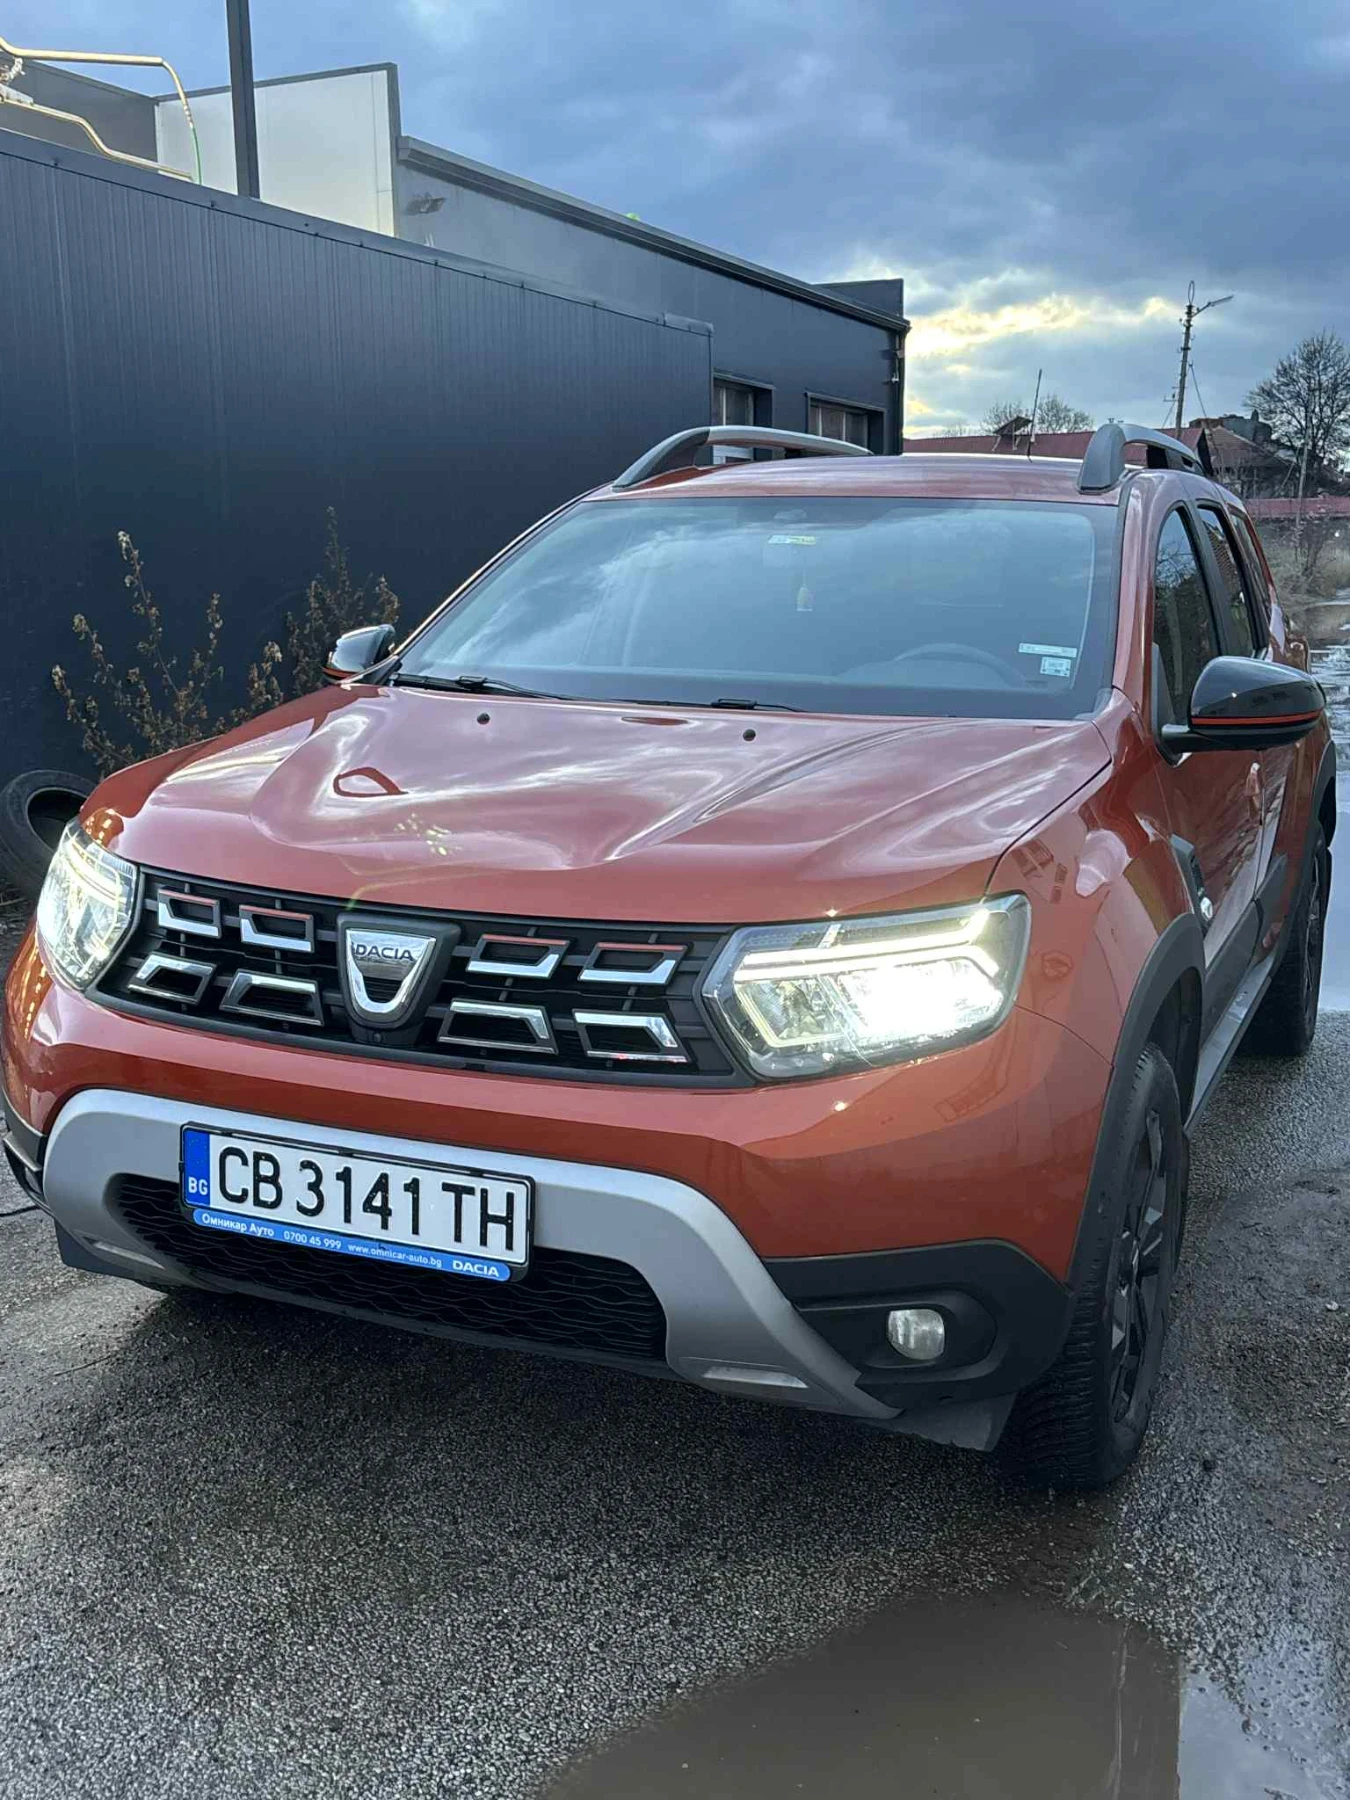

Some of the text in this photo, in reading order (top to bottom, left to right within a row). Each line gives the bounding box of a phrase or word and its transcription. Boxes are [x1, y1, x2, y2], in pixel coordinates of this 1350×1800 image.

[355, 942, 413, 962] DACIA
[188, 1177, 208, 1196] BG
[296, 1160, 421, 1236] 3141
[202, 1213, 275, 1237] Омникар Ауто
[283, 1231, 342, 1250] 0700 45 999
[347, 1244, 442, 1268] www.omnicar-auto.bg
[452, 1259, 500, 1278] DACIA
